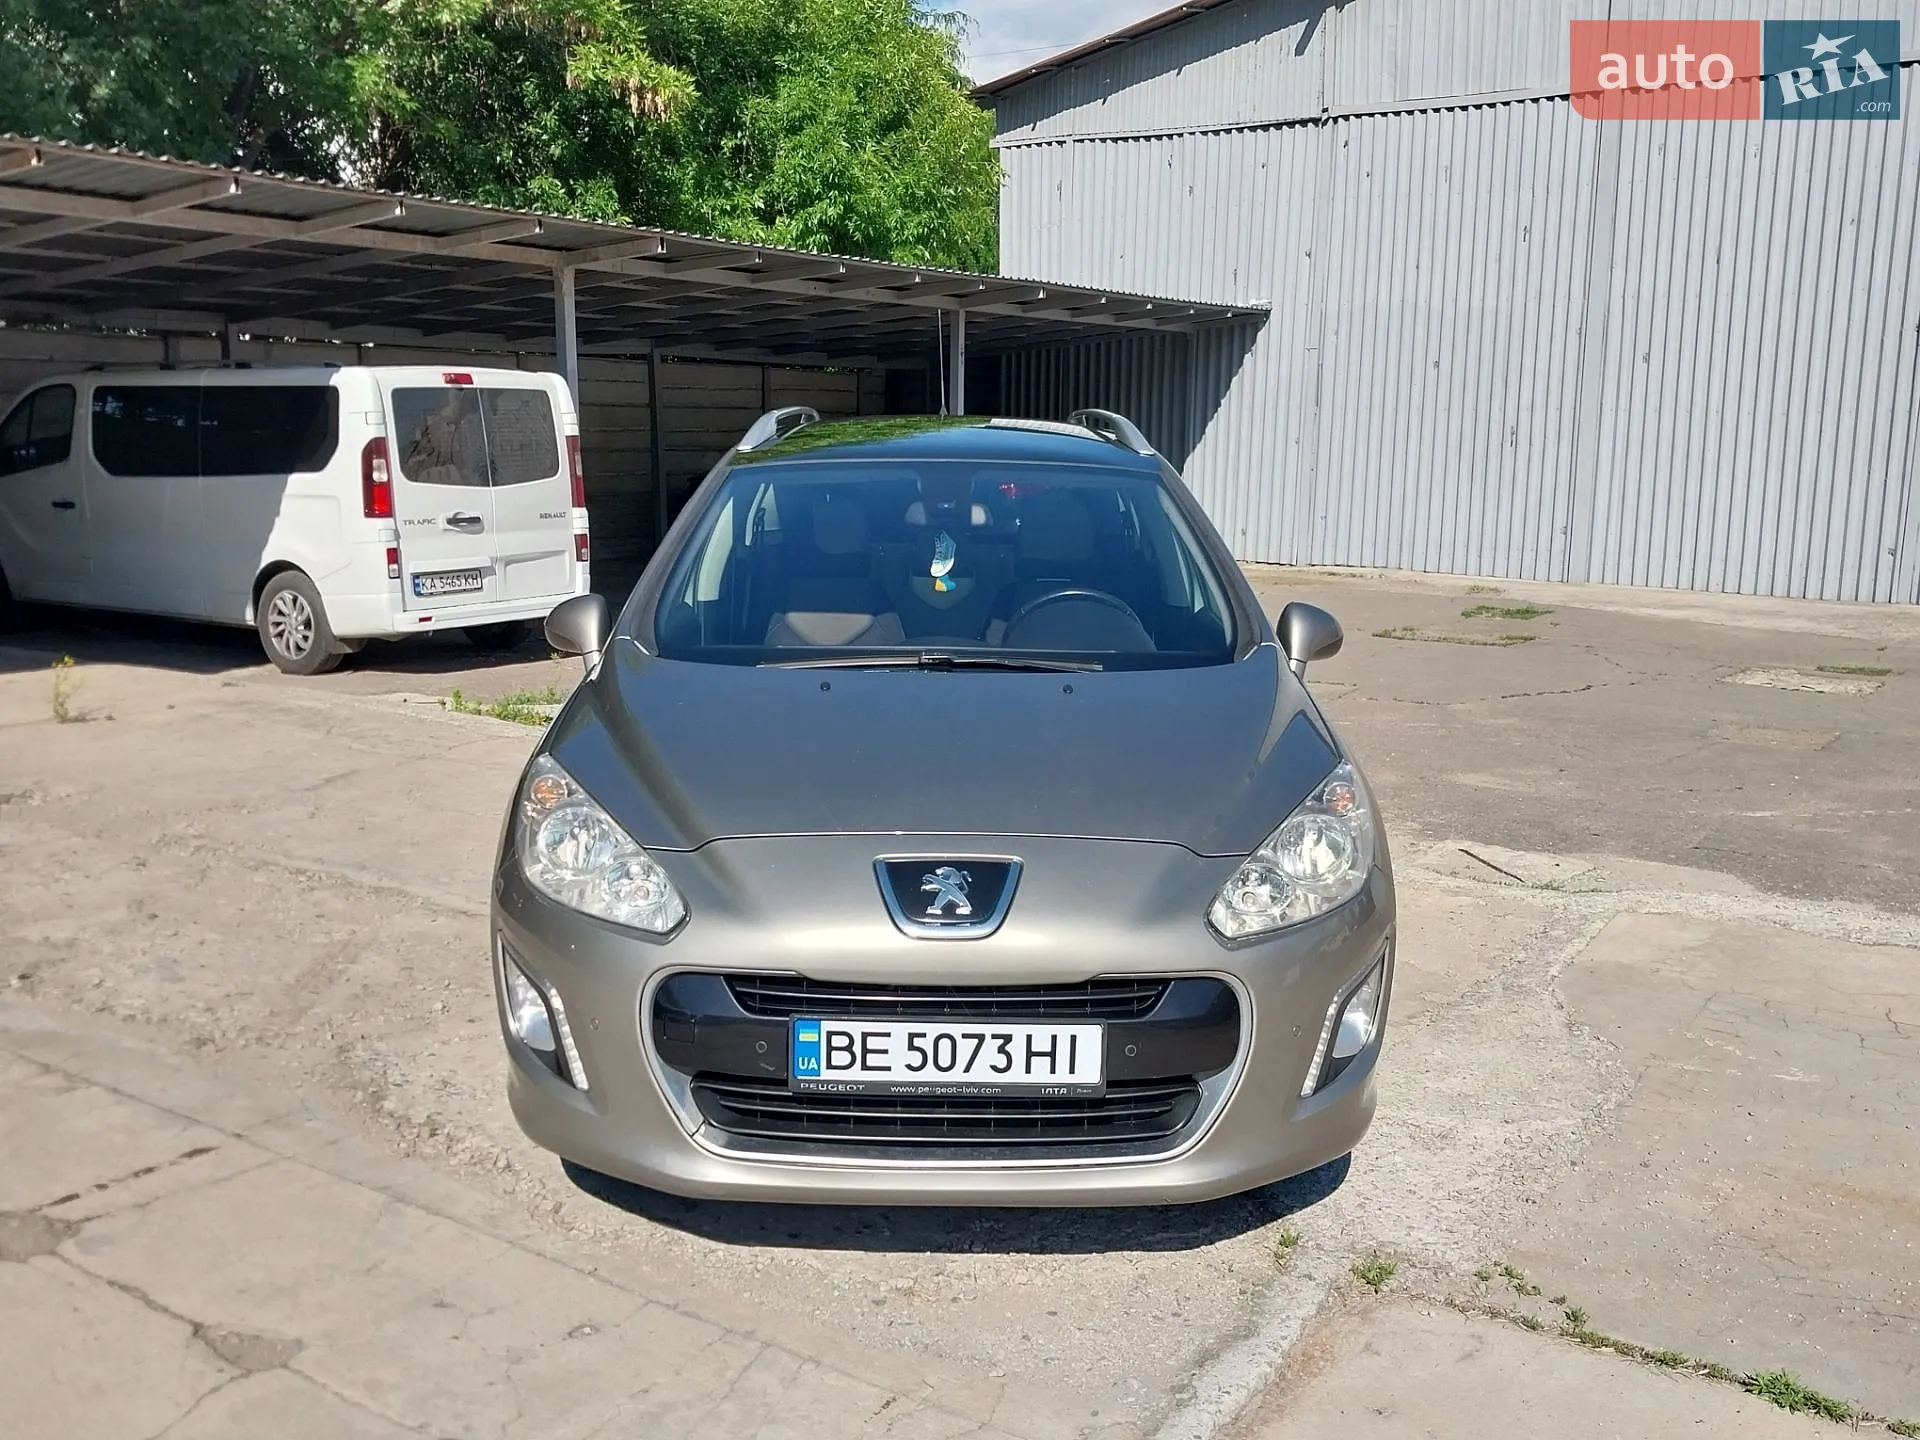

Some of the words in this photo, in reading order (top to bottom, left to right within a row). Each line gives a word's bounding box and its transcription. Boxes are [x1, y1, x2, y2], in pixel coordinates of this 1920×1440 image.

[539, 511, 567, 519] RENAULT
[402, 518, 437, 526] TRAFIC
[421, 577, 437, 591] KA
[439, 575, 462, 589] 5465
[463, 573, 479, 586] KH
[825, 1030, 892, 1072] BE
[904, 1033, 1013, 1074] 5073
[1024, 1033, 1077, 1075] HI
[798, 1056, 819, 1071] UA
[800, 1082, 865, 1092] PEUGEOT
